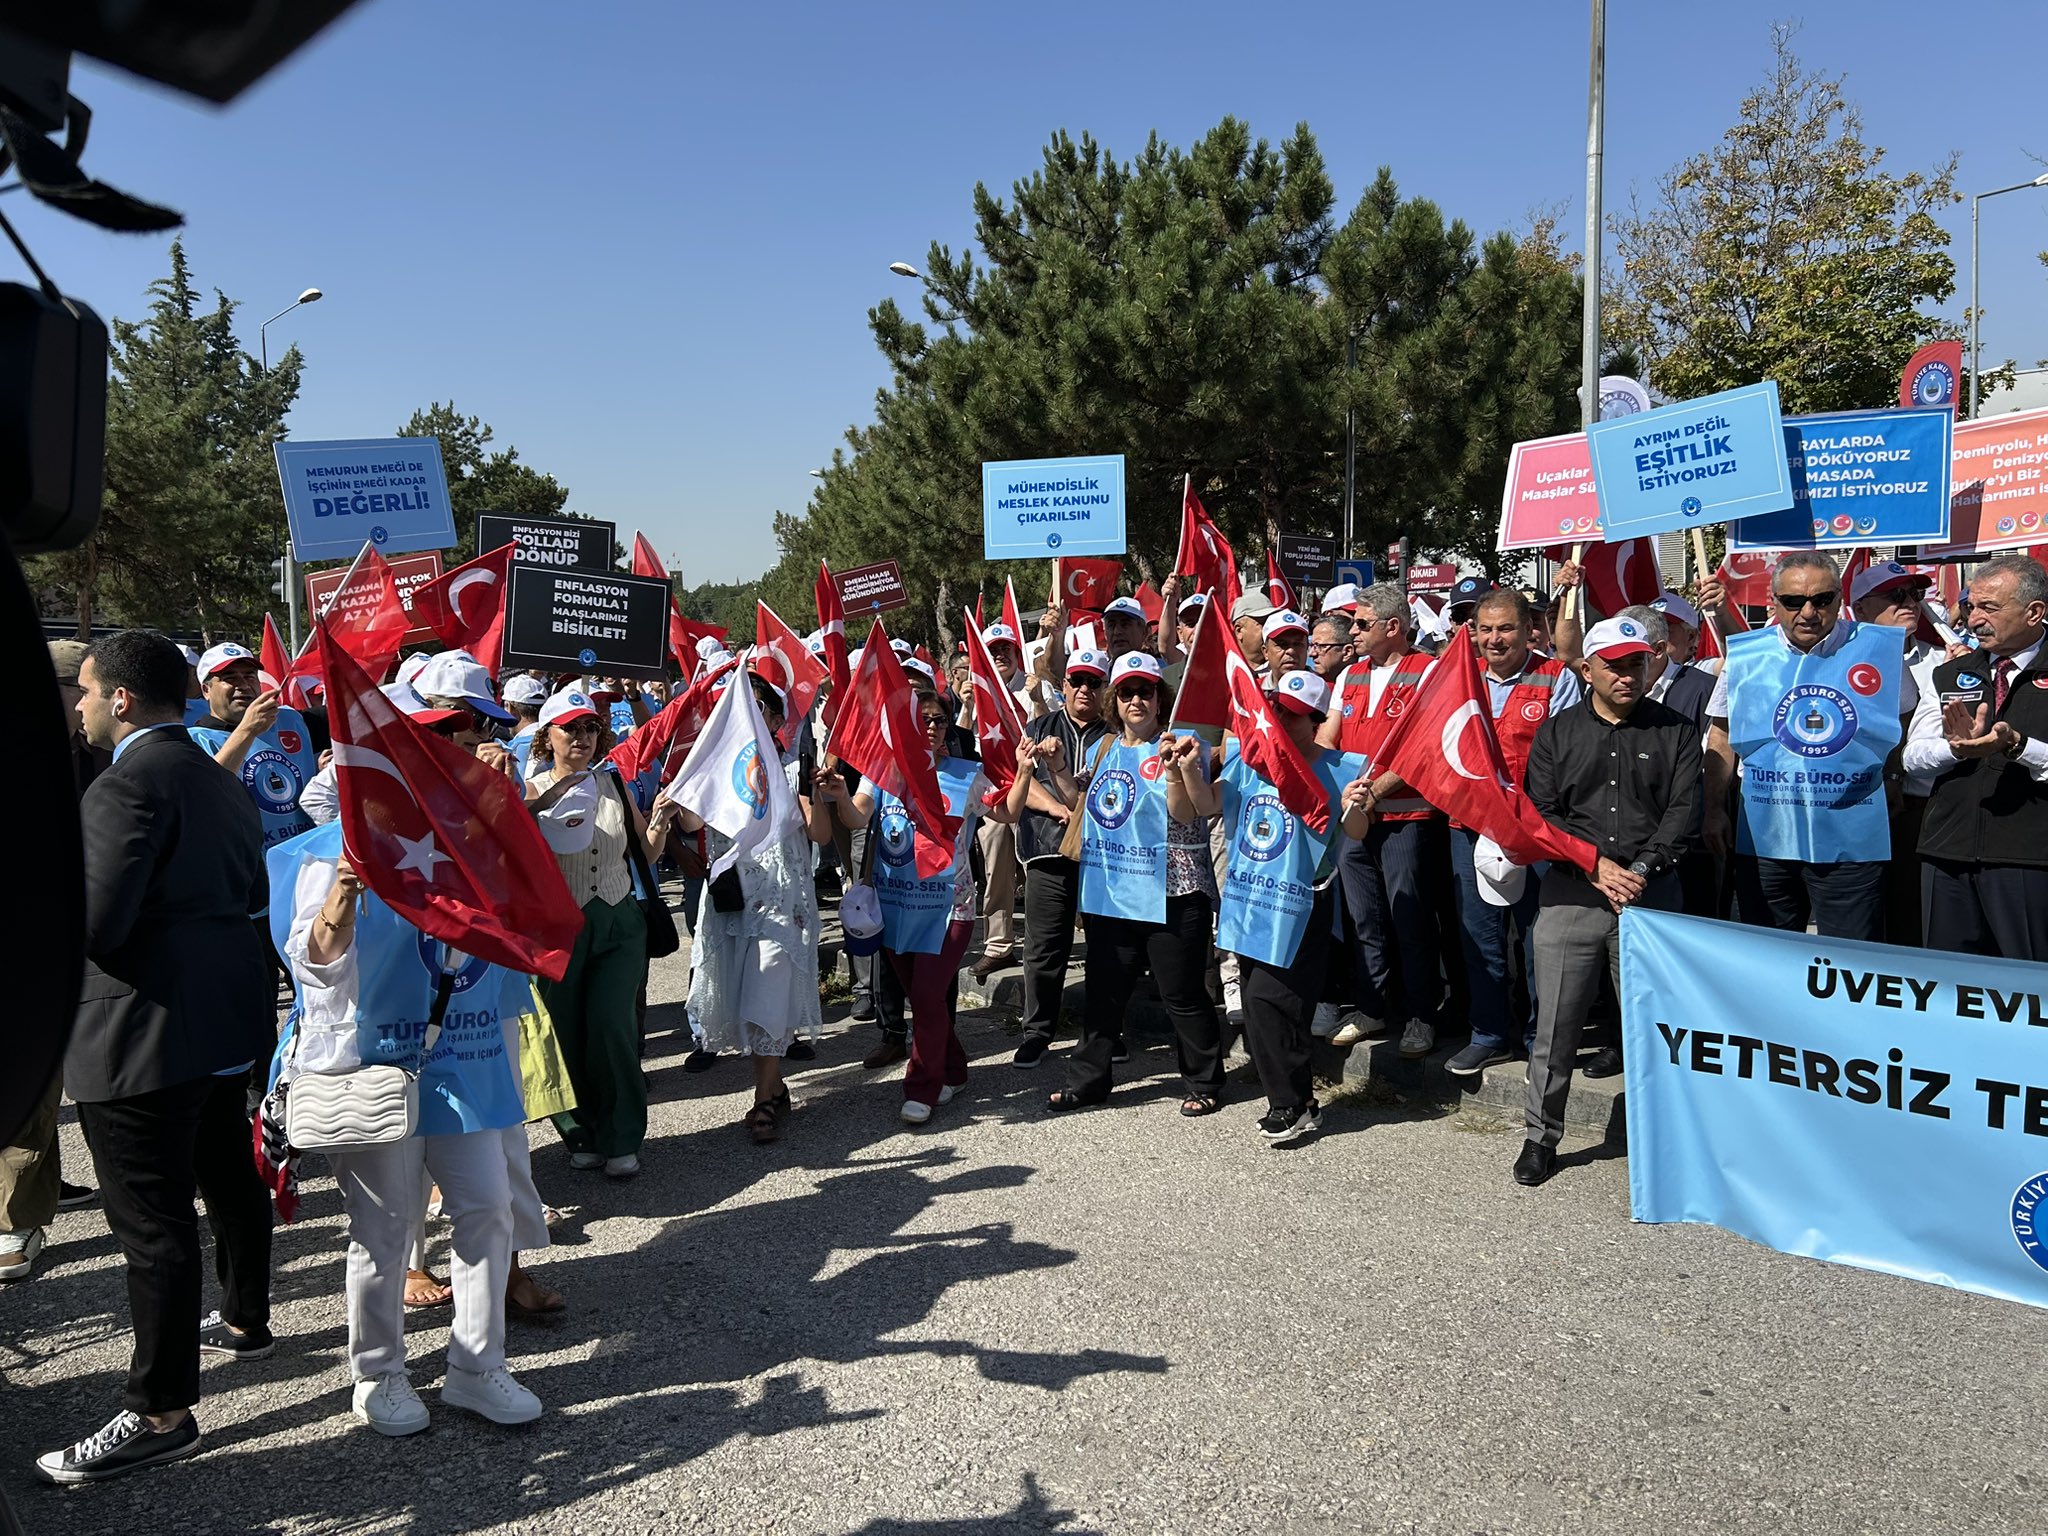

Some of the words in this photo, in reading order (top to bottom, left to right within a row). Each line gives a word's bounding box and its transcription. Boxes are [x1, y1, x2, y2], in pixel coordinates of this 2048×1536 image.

[1633, 428, 1680, 448] AYRIM
[1684, 415, 1730, 437] DEĞİL
[1798, 435, 1885, 451] RAYLARDA
[1953, 438, 2033, 461] Demiryolu,
[1635, 433, 1733, 473] EŞİTLİK
[1807, 449, 1911, 467] DÖKÜYORUZ
[306, 465, 368, 477] MEMURUN
[371, 461, 406, 474] EMEĞİ
[408, 462, 423, 472] DE
[1536, 467, 1590, 484] Uçaklar
[1638, 460, 1737, 491] İSTİYORUZ!
[1806, 468, 1875, 483] MASADA
[307, 479, 351, 493] İŞÇİNİN
[353, 476, 387, 489] EMEĞİ
[390, 476, 426, 486] KADAR
[1008, 477, 1099, 494] MÜHENDİSLİK
[1841, 481, 1929, 497] İSTİYORUZ
[1951, 471, 2013, 492] ürkiye'yi
[2017, 468, 2041, 481] Biz
[312, 485, 430, 518] DEĞERLİ!
[998, 497, 1049, 509] MESLEK
[1053, 494, 1110, 506] KANUNU
[1521, 486, 1576, 502] Maaşlar
[1017, 510, 1091, 526] ÇIKARILSIN
[512, 526, 561, 537] ENFLASYON
[563, 529, 580, 538] BİZİ
[512, 533, 579, 550] SOLLADI
[513, 546, 579, 566] DÖNÜP
[410, 572, 432, 585] ÇOK
[1410, 567, 1438, 579] DİKMEN
[554, 579, 629, 597] ENFLASYON
[553, 592, 620, 610] FORMULA
[622, 601, 629, 610] 1
[552, 606, 628, 623] MAAŞLARIMIZ
[552, 618, 627, 640] BİSİKLET!
[1776, 692, 1798, 721] TÜRK
[1800, 687, 1854, 721] BÜRO-SEN
[1801, 746, 1829, 755] 1992
[244, 762, 257, 787] TÜRK
[1751, 767, 1789, 783] TÜRK
[1795, 768, 1874, 784] BÜRO-SEN
[276, 802, 295, 812] 1992
[1257, 796, 1293, 833] BÜRO-SEN
[1096, 838, 1157, 858] BÜRO-SEN
[1249, 850, 1268, 860] 1992
[1240, 870, 1307, 897] BÜRO-SEN
[1806, 956, 1938, 1013] ÜVEY
[1956, 984, 2048, 1029] EVL
[377, 1018, 430, 1044] TÜR
[1655, 1022, 1951, 1121] YETERSİZ
[1974, 1077, 2048, 1138] TE
[2015, 1177, 2048, 1250] TÜRKİY
